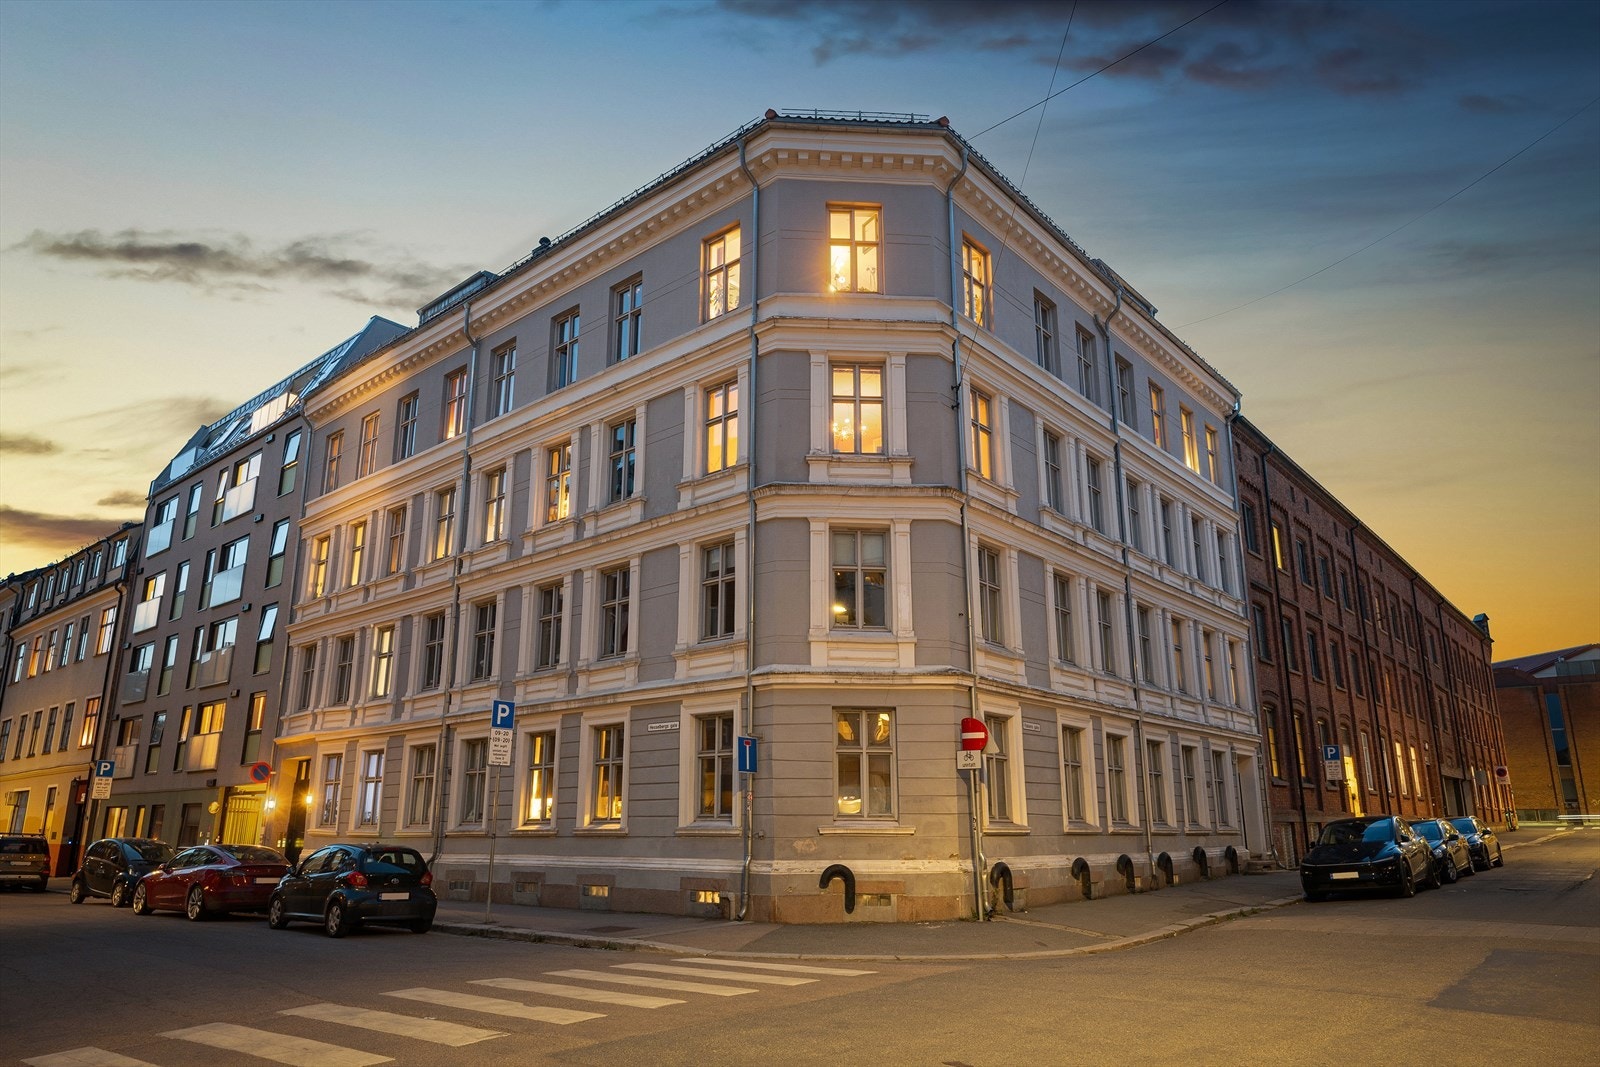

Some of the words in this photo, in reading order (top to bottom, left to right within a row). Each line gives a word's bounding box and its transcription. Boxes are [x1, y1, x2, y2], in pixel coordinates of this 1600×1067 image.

[497, 704, 510, 725] P
[1327, 747, 1336, 759] P
[100, 762, 111, 776] P
